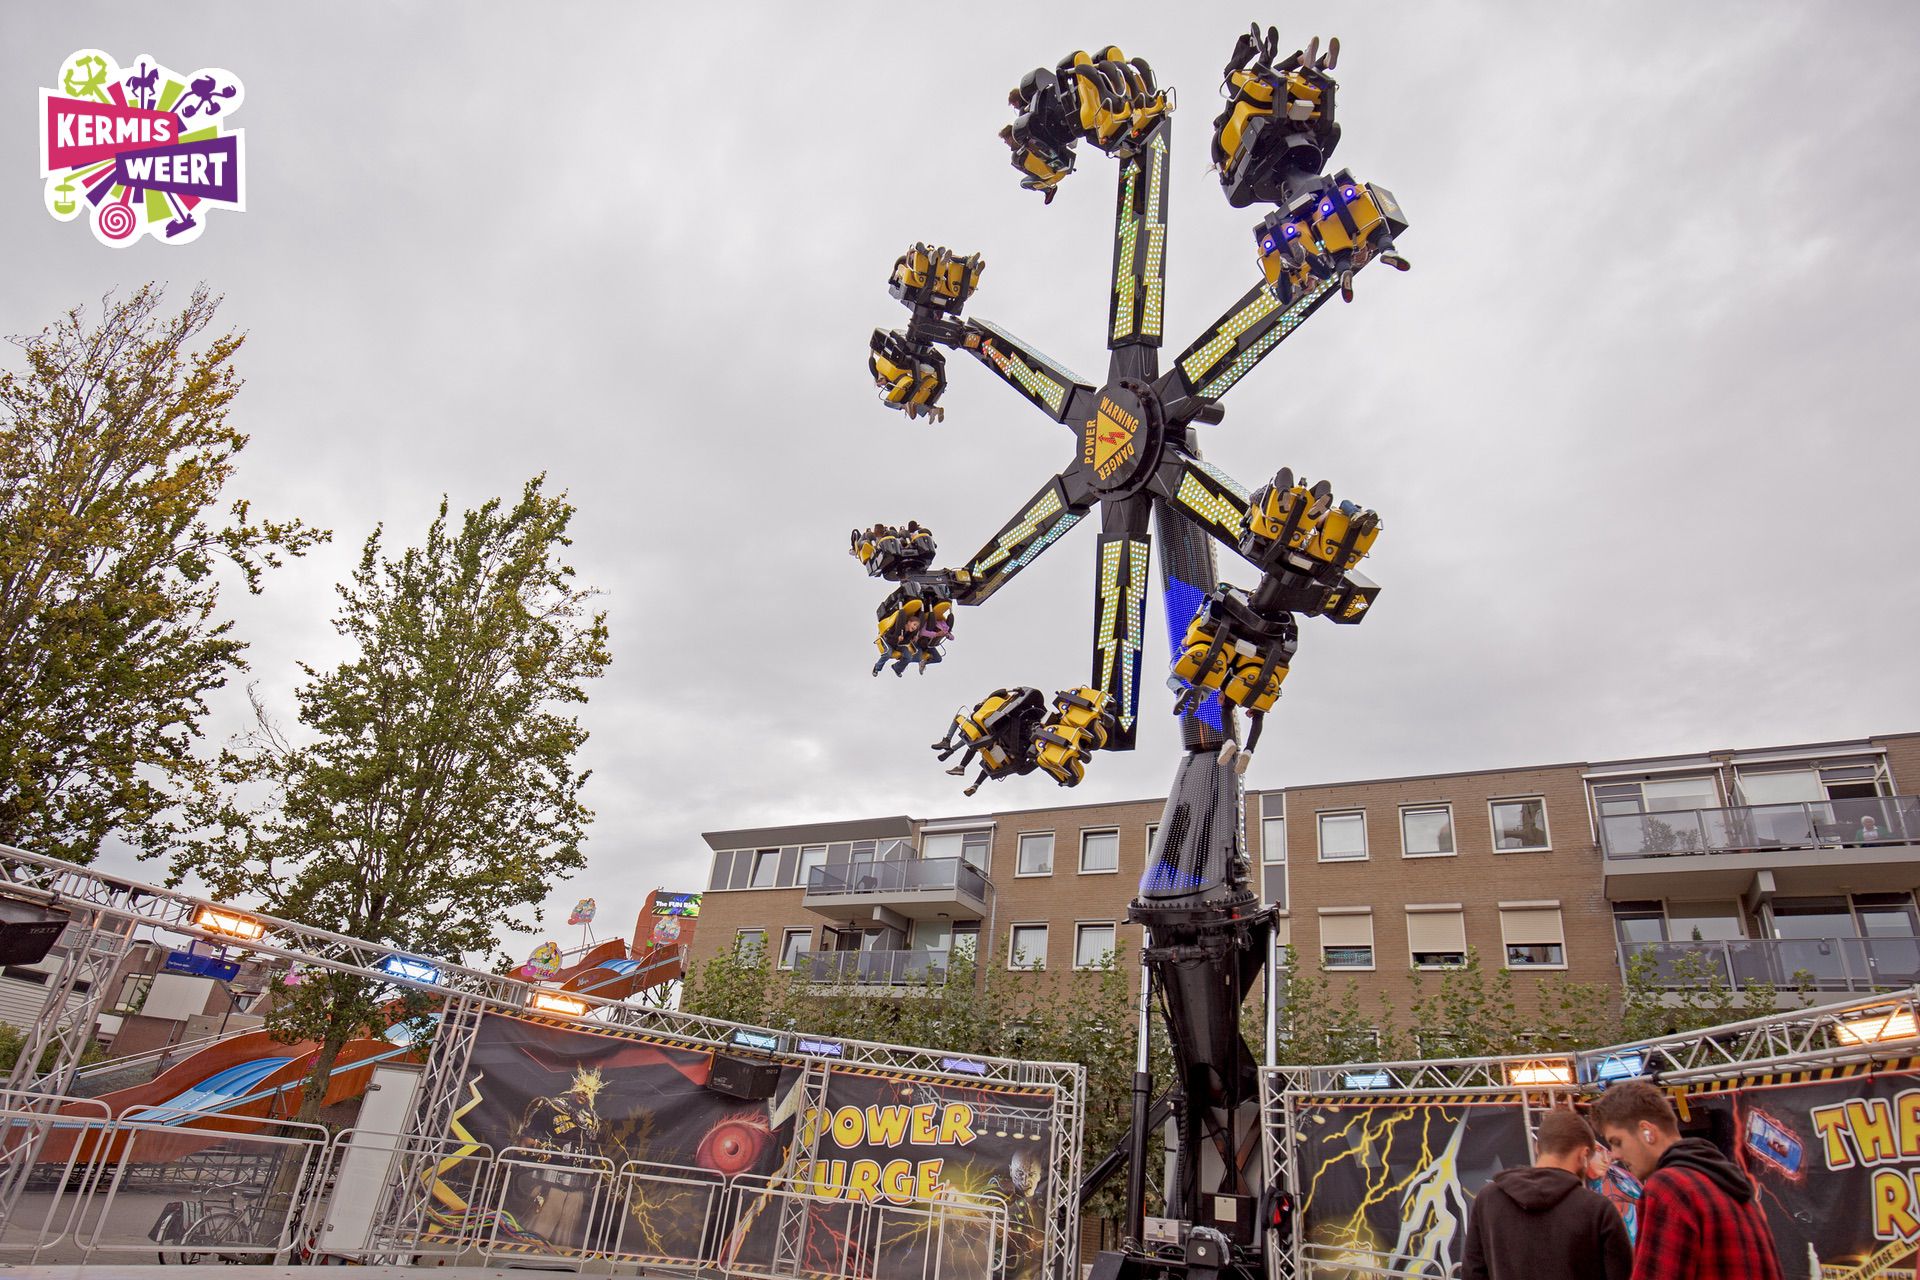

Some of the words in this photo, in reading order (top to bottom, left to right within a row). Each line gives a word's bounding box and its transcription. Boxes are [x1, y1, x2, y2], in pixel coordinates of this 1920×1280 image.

[1100, 396, 1139, 433] WARNING
[1084, 419, 1096, 464] POWER
[1098, 442, 1135, 481] DANGER
[801, 1104, 977, 1149] POWER
[791, 1159, 945, 1205] SURGE
[1860, 1248, 1895, 1279] VOLTAGE
